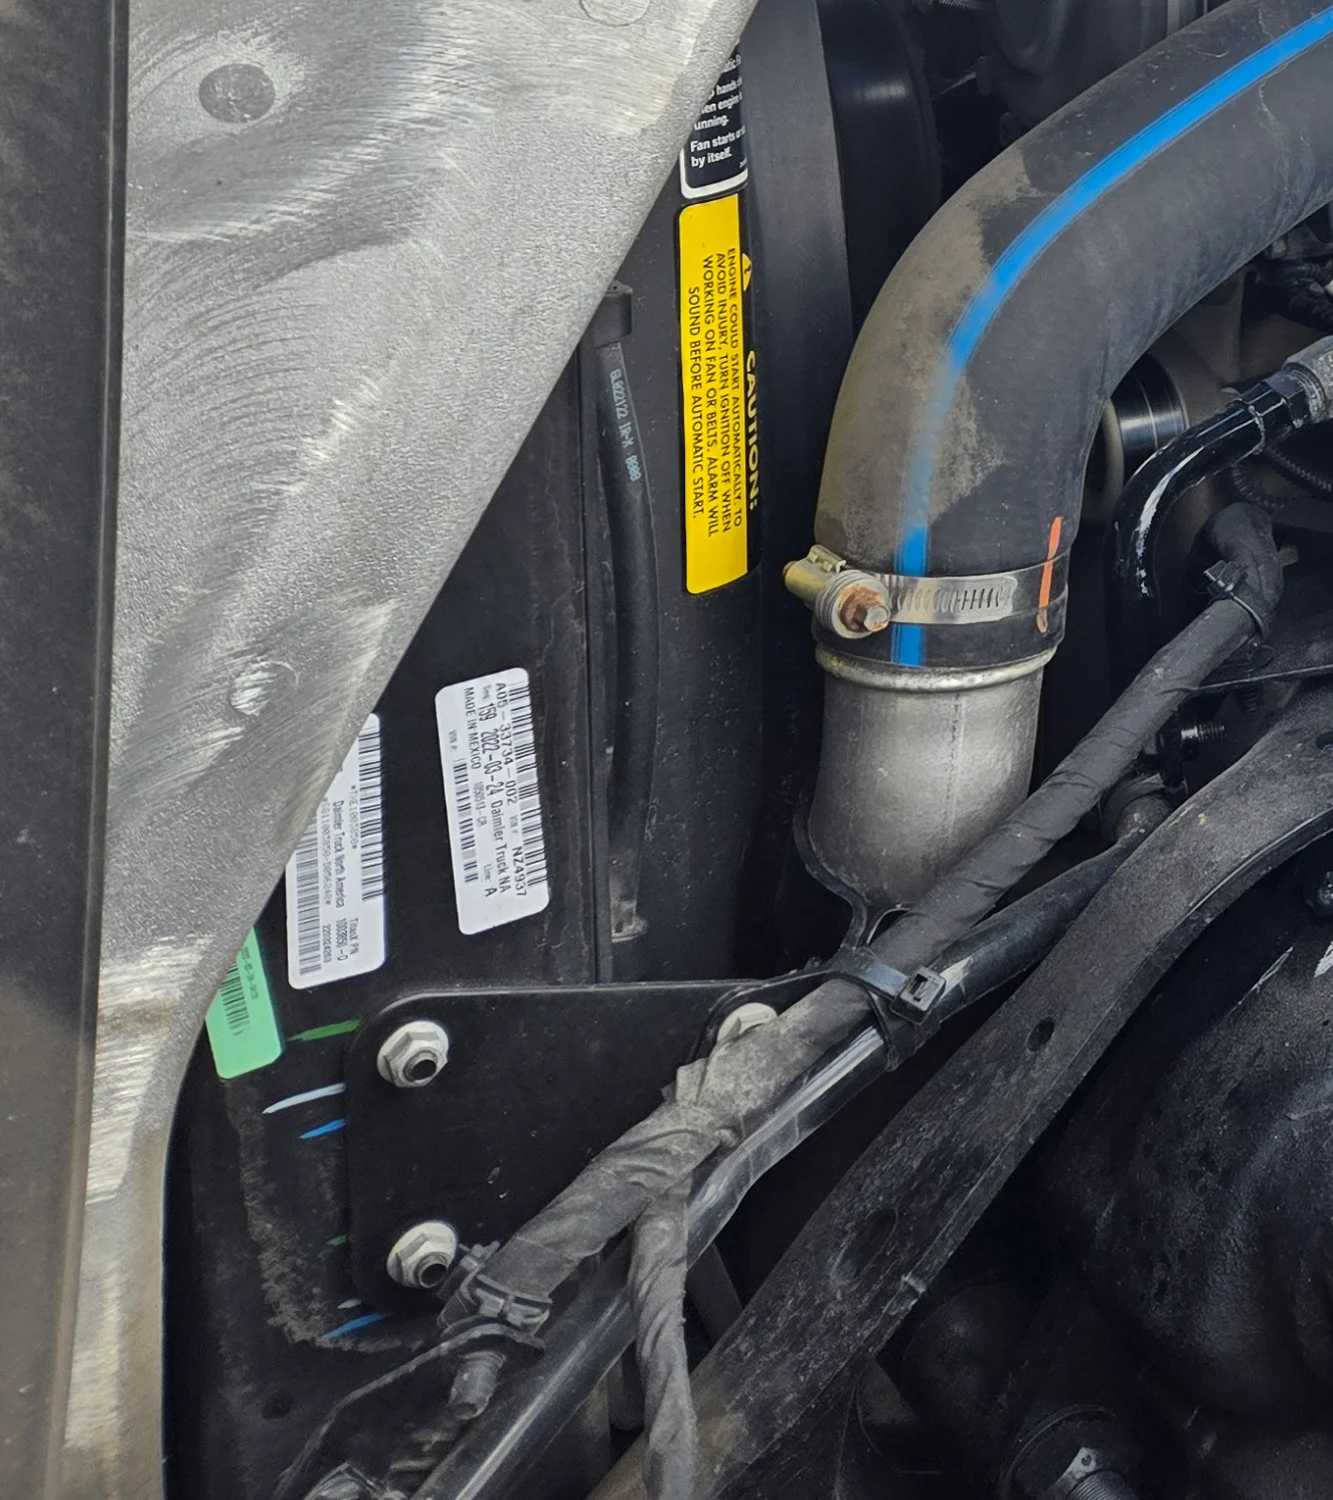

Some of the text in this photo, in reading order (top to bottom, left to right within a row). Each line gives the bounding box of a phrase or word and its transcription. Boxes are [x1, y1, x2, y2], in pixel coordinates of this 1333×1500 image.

[690, 140, 710, 153] Fan
[712, 131, 735, 148] starts
[693, 114, 729, 131] unning.
[690, 156, 705, 168] by
[707, 146, 732, 163] itself.
[716, 253, 726, 295] AVOID
[727, 248, 738, 300] ENGINE
[729, 304, 739, 349] COULD
[719, 353, 729, 391] TURN
[731, 353, 740, 391] START
[688, 286, 704, 519] SOUND BEFORE AUTOMATIC START.
[702, 254, 719, 537] WORKING ON FAN OR BELTS. ALARM WILL
[720, 394, 731, 457] IGNITION
[746, 350, 759, 511] CAUTION:
[721, 461, 731, 485] OFF
[722, 488, 732, 533] WHEN
[733, 508, 742, 527] TO
[464, 687, 497, 898] MADE IN MEXICO A
[478, 702, 511, 894] 159 2022-03-24 Daimler Truck NA
[333, 800, 346, 908] Daimler Truck North America
[512, 845, 527, 896] NZ4937
